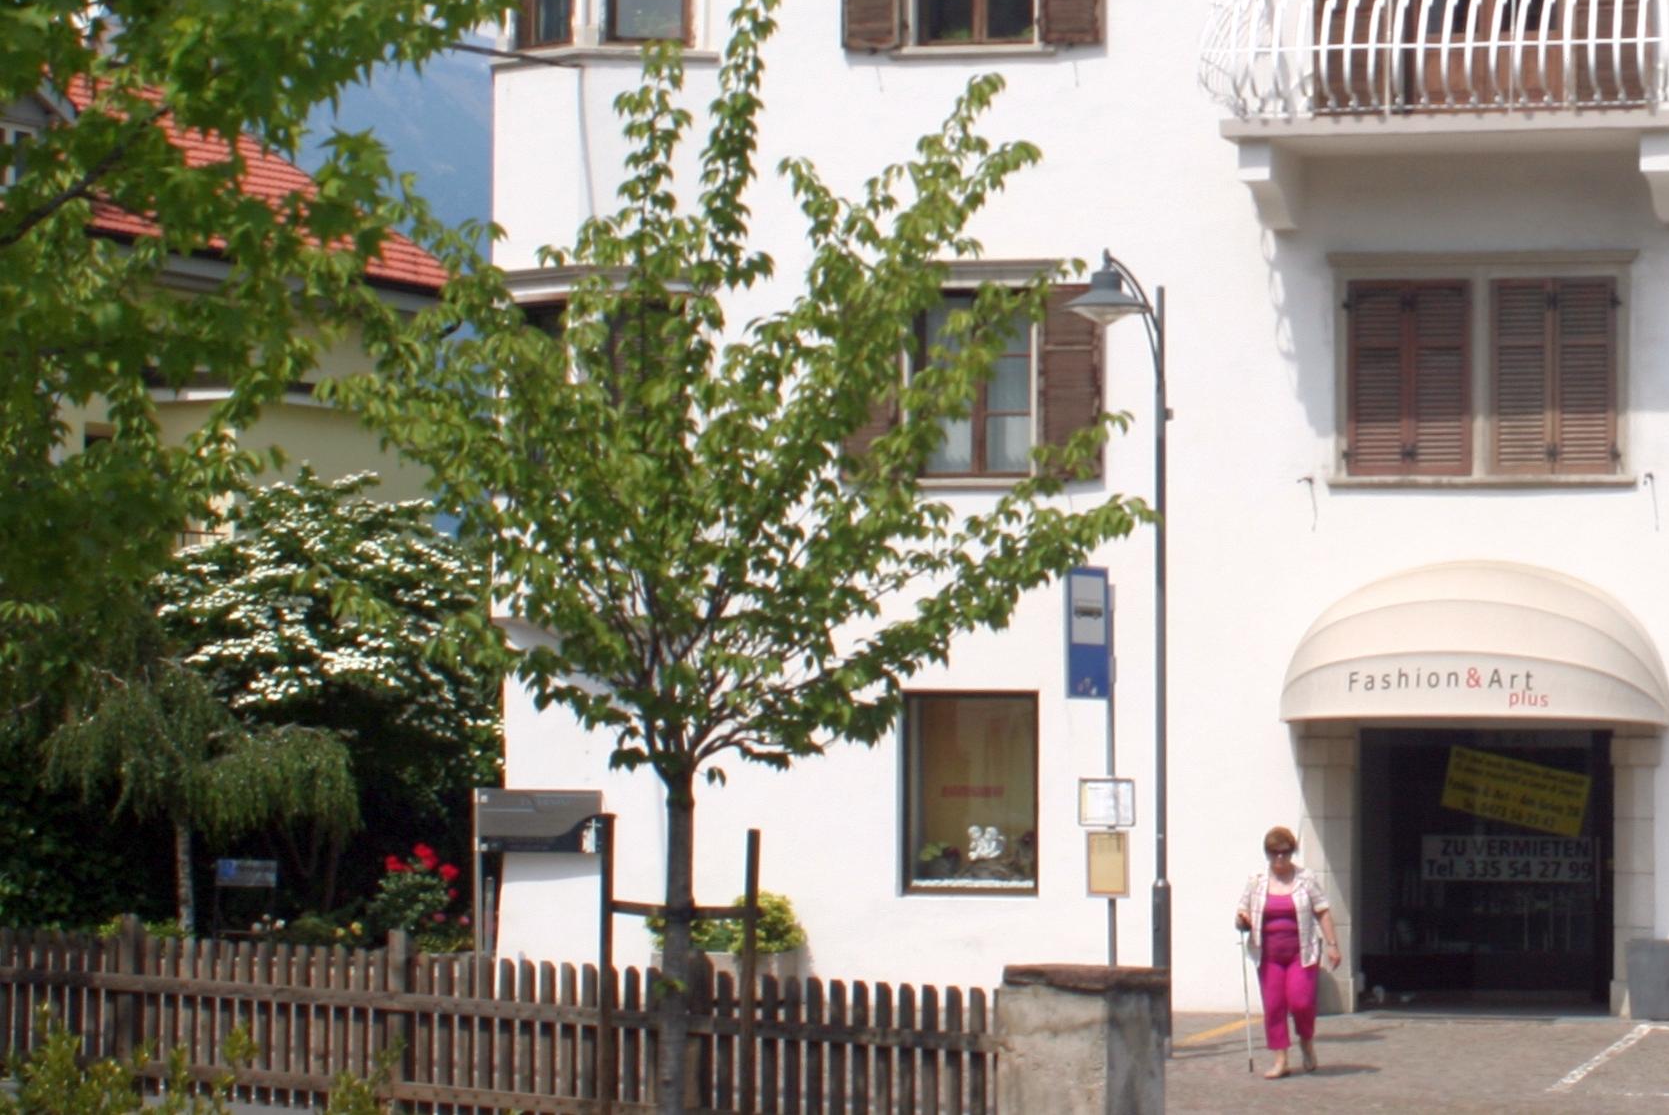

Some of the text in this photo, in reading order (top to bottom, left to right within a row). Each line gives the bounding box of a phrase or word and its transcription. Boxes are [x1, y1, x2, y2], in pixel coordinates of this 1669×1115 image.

[1508, 689, 1550, 708] plus
[1440, 839, 1590, 857] ZU VERMIETEN
[1465, 859, 1502, 878] 335
[1508, 860, 1532, 878] 54
[1537, 860, 1562, 878] 27
